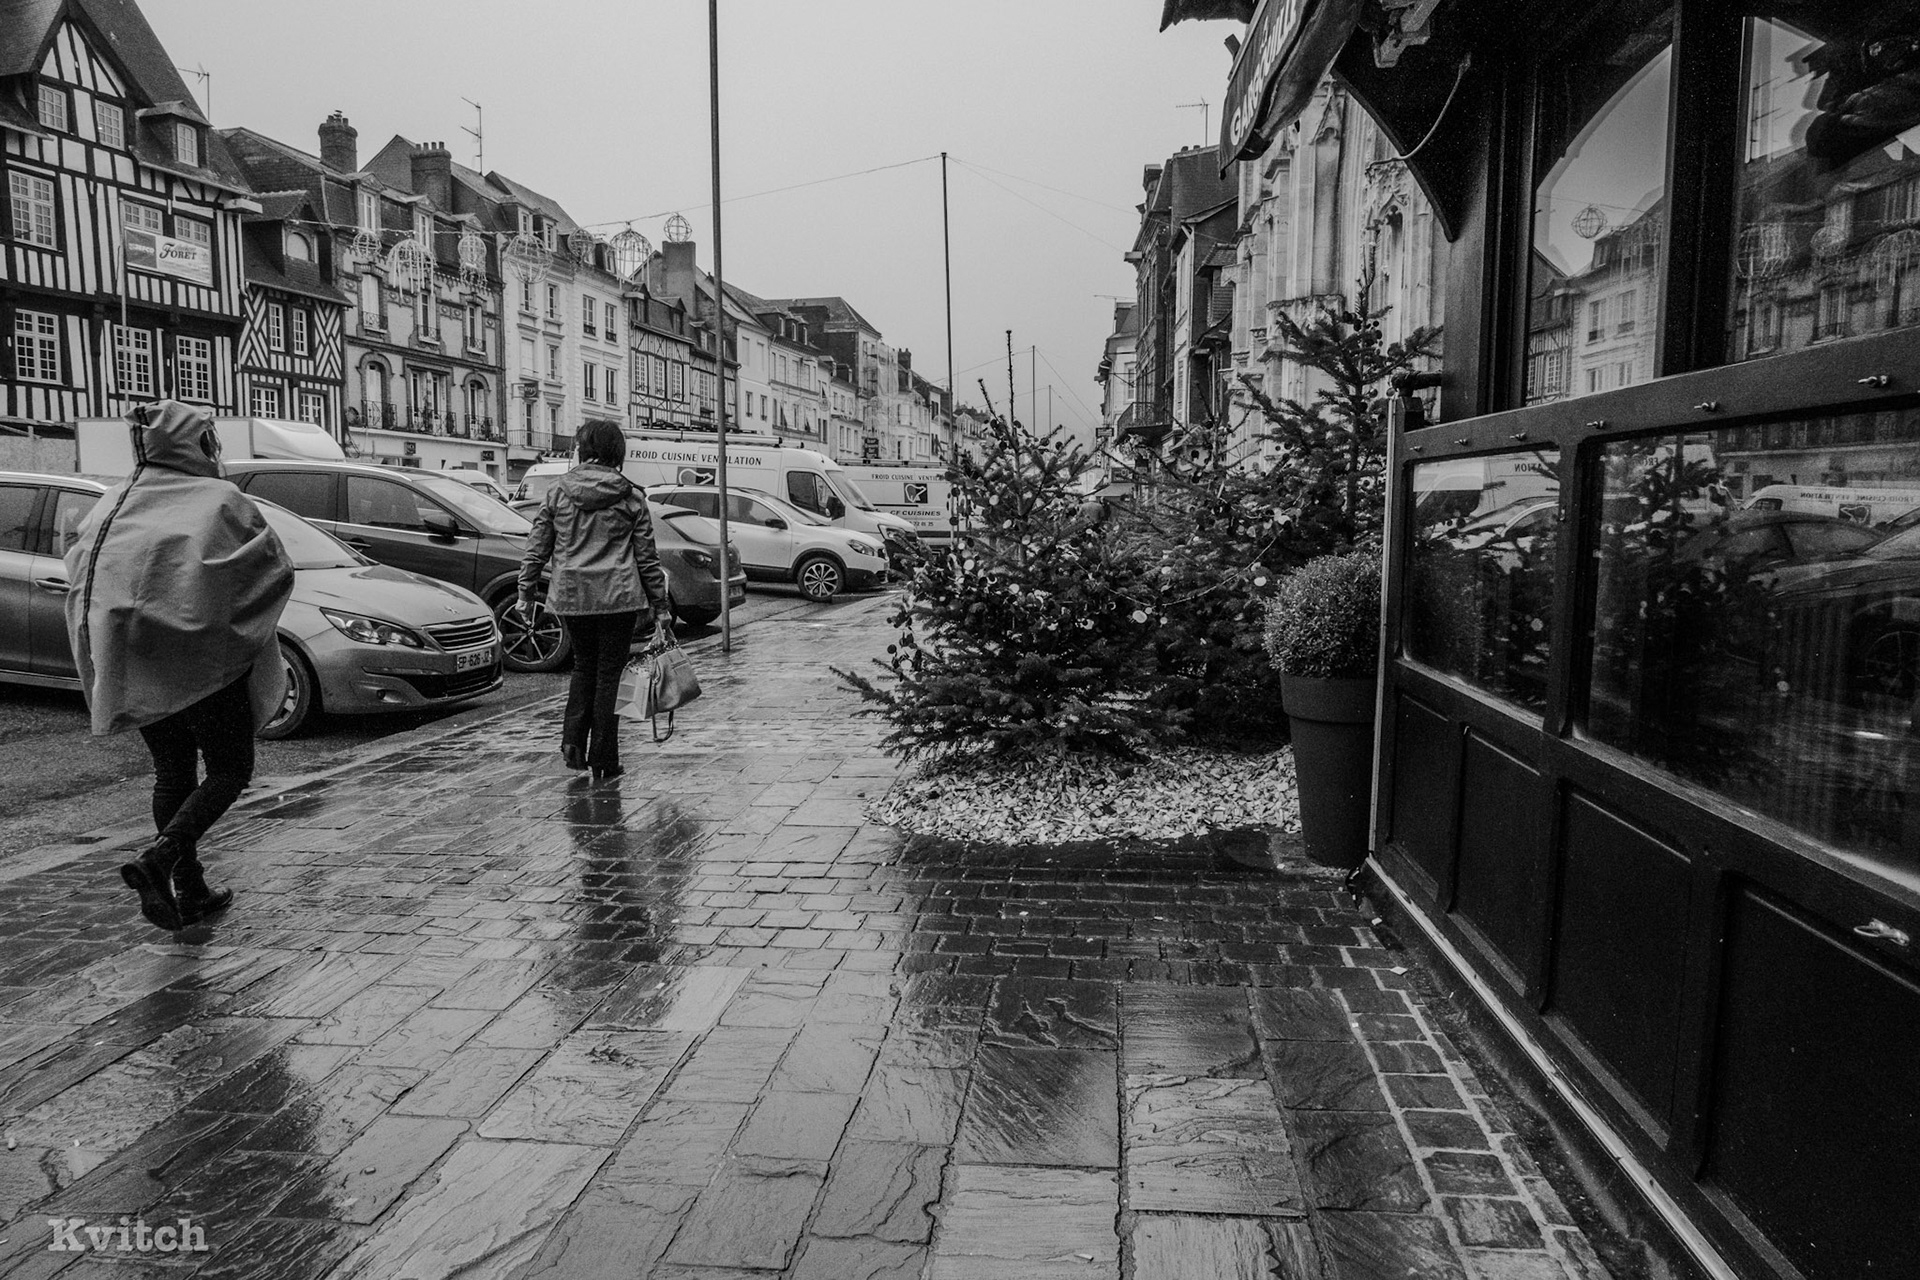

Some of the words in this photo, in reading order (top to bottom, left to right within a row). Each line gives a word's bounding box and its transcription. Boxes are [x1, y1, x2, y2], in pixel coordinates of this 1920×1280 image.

[630, 449, 658, 460] FROID
[661, 451, 697, 462] CUISINE
[701, 453, 762, 466] VENILATION
